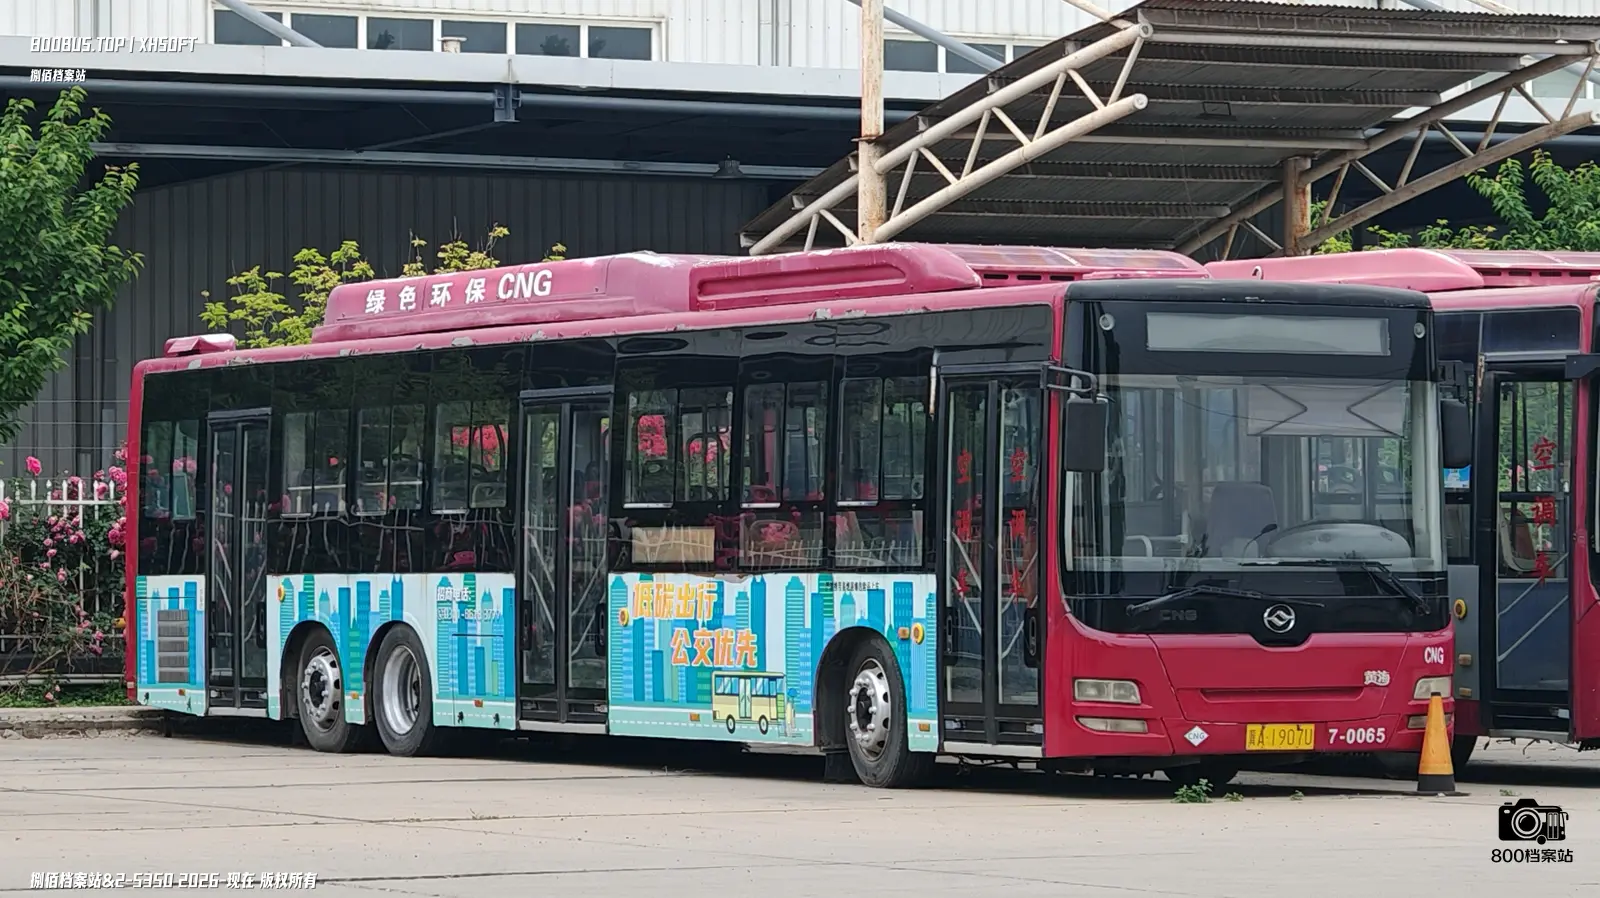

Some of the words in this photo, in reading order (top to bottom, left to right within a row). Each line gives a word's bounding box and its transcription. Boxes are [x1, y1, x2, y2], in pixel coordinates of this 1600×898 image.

[364, 277, 487, 314] 绿色环保
[498, 269, 553, 300] CNG
[1530, 436, 1558, 584] 空调车
[1007, 447, 1028, 602] 空调车
[633, 582, 718, 620] 低碳出行
[1160, 609, 1198, 621] CNG
[670, 627, 758, 667] 公交优先
[1424, 646, 1445, 665] CNG
[1364, 670, 1390, 686] 黄海
[1187, 732, 1205, 741] CNG
[1328, 727, 1386, 745] 7-0065
